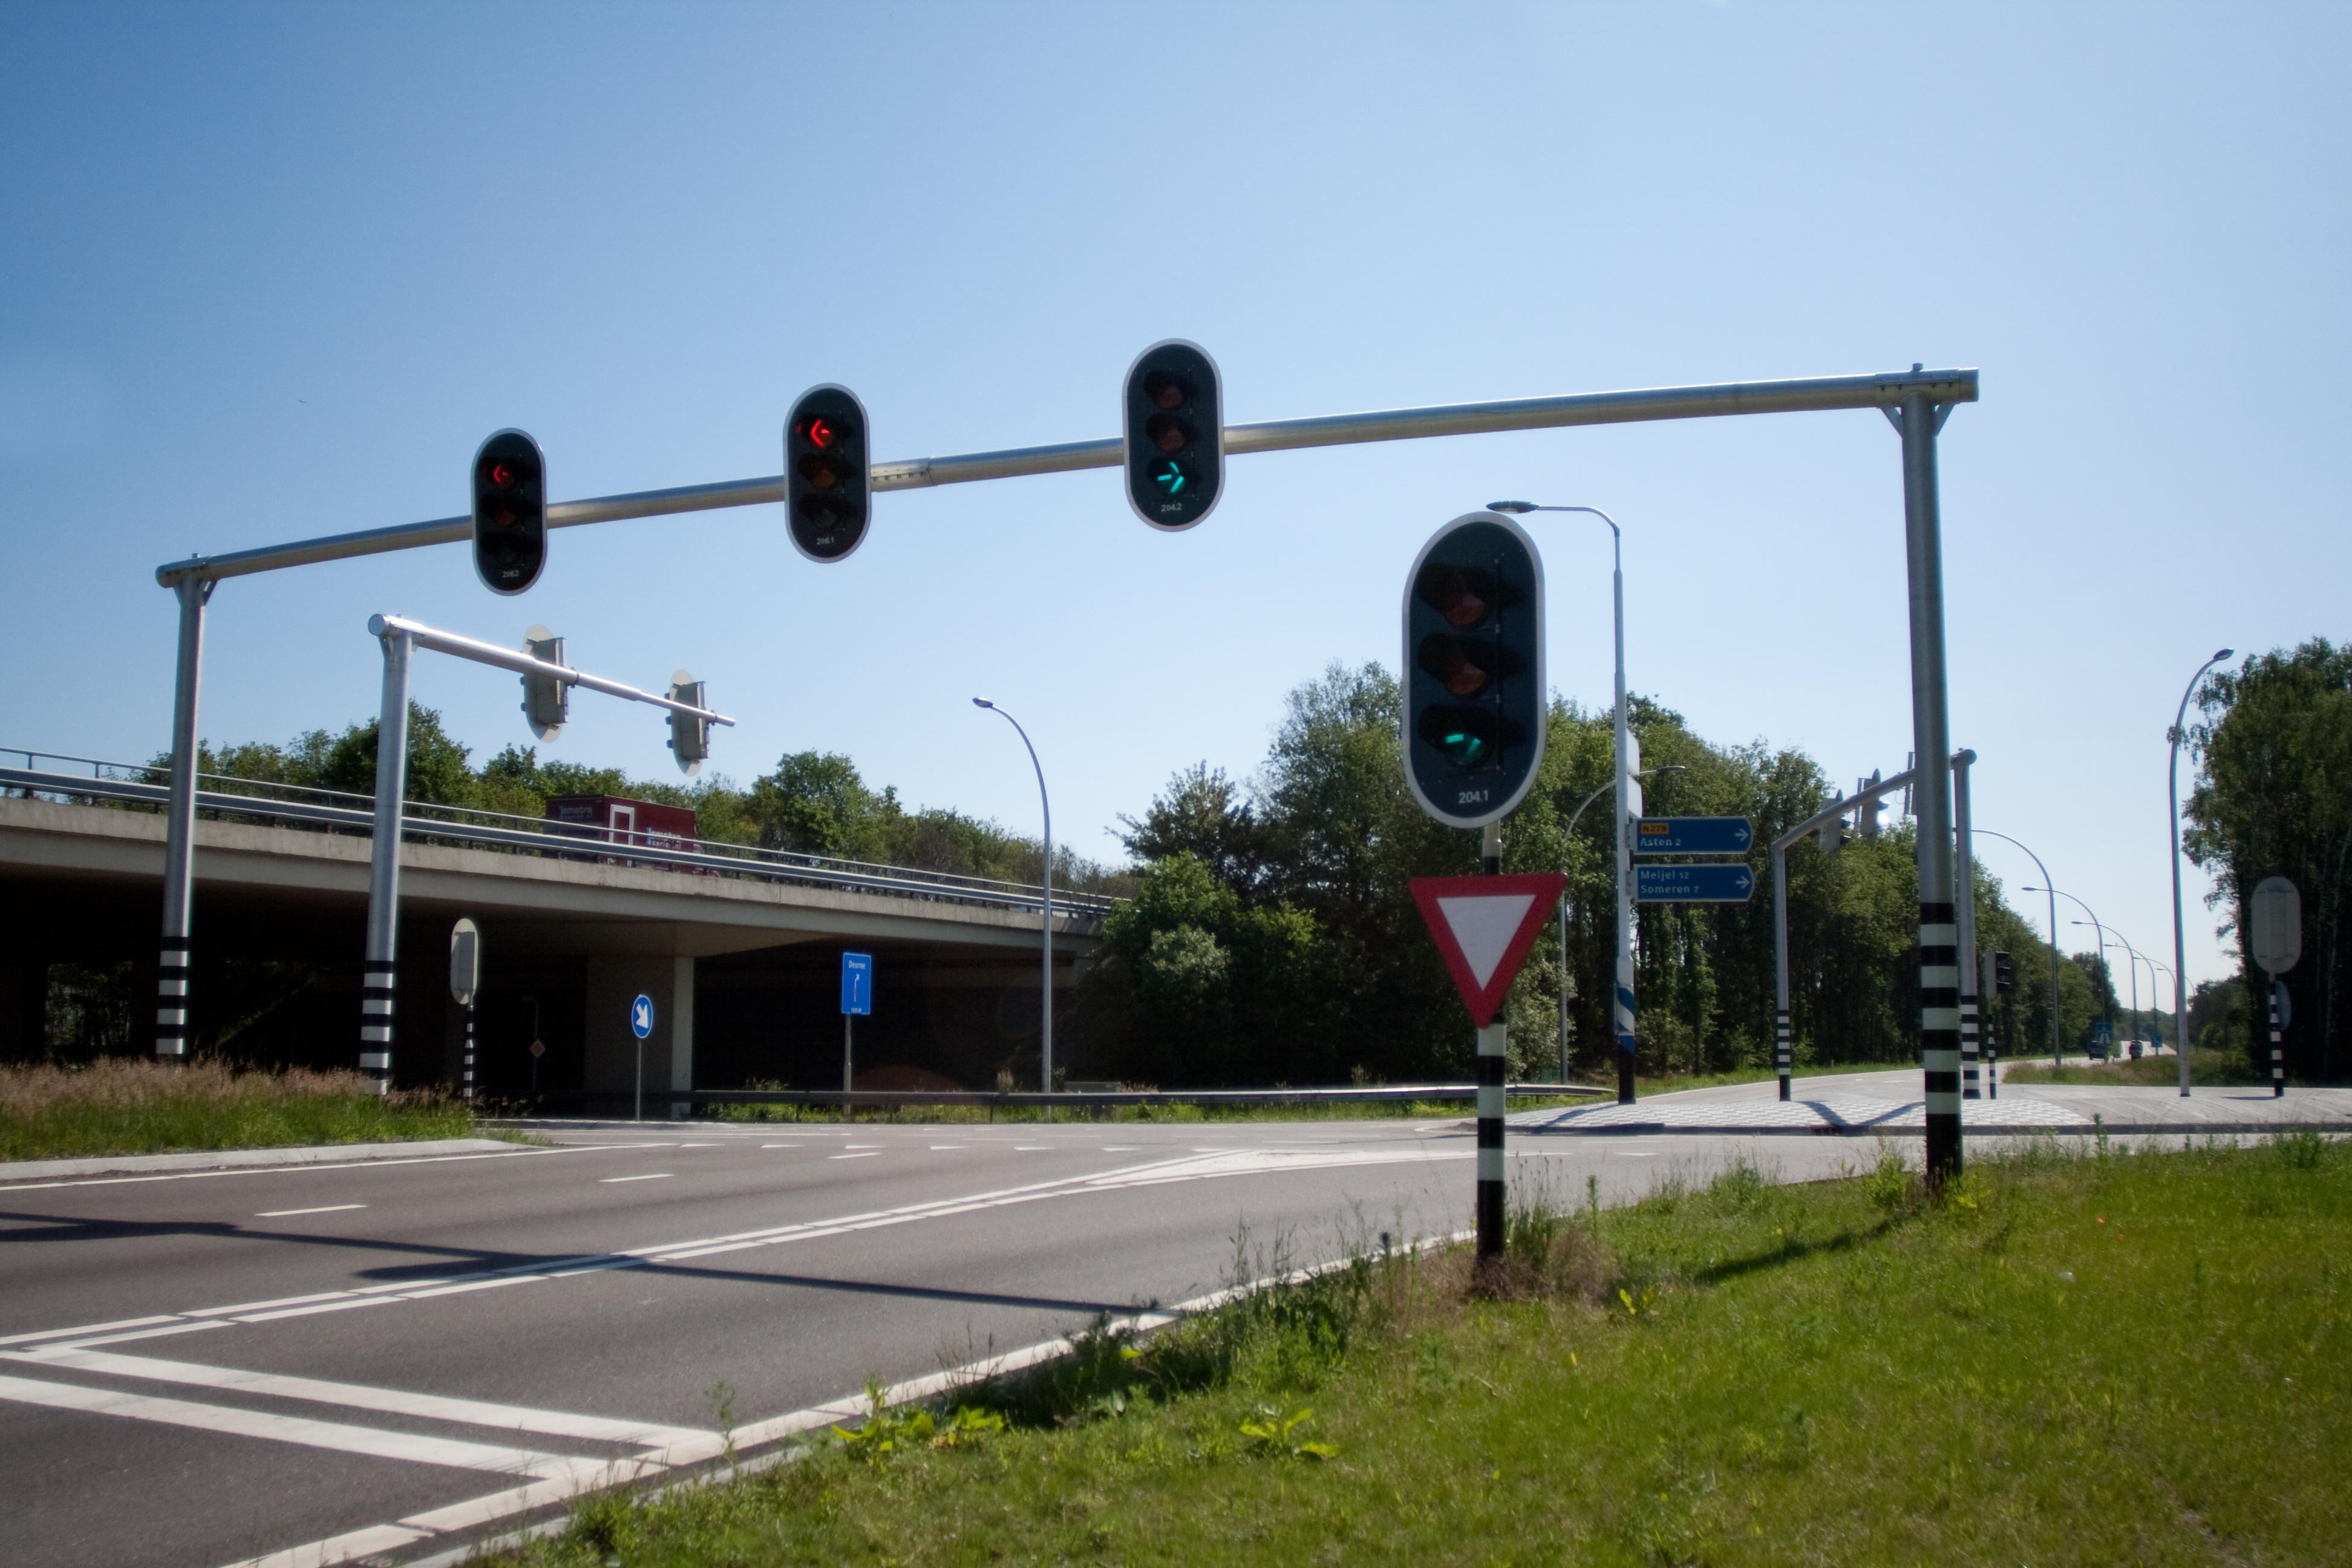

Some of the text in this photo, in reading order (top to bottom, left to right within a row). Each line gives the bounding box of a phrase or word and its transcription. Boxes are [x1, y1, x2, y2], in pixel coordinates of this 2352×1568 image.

[1458, 789, 1489, 804] 204.1
[1640, 838, 1672, 846] Asten
[1641, 870, 1675, 882] Meijel
[1641, 884, 1690, 893] Someren
[848, 959, 865, 969] Deurne
